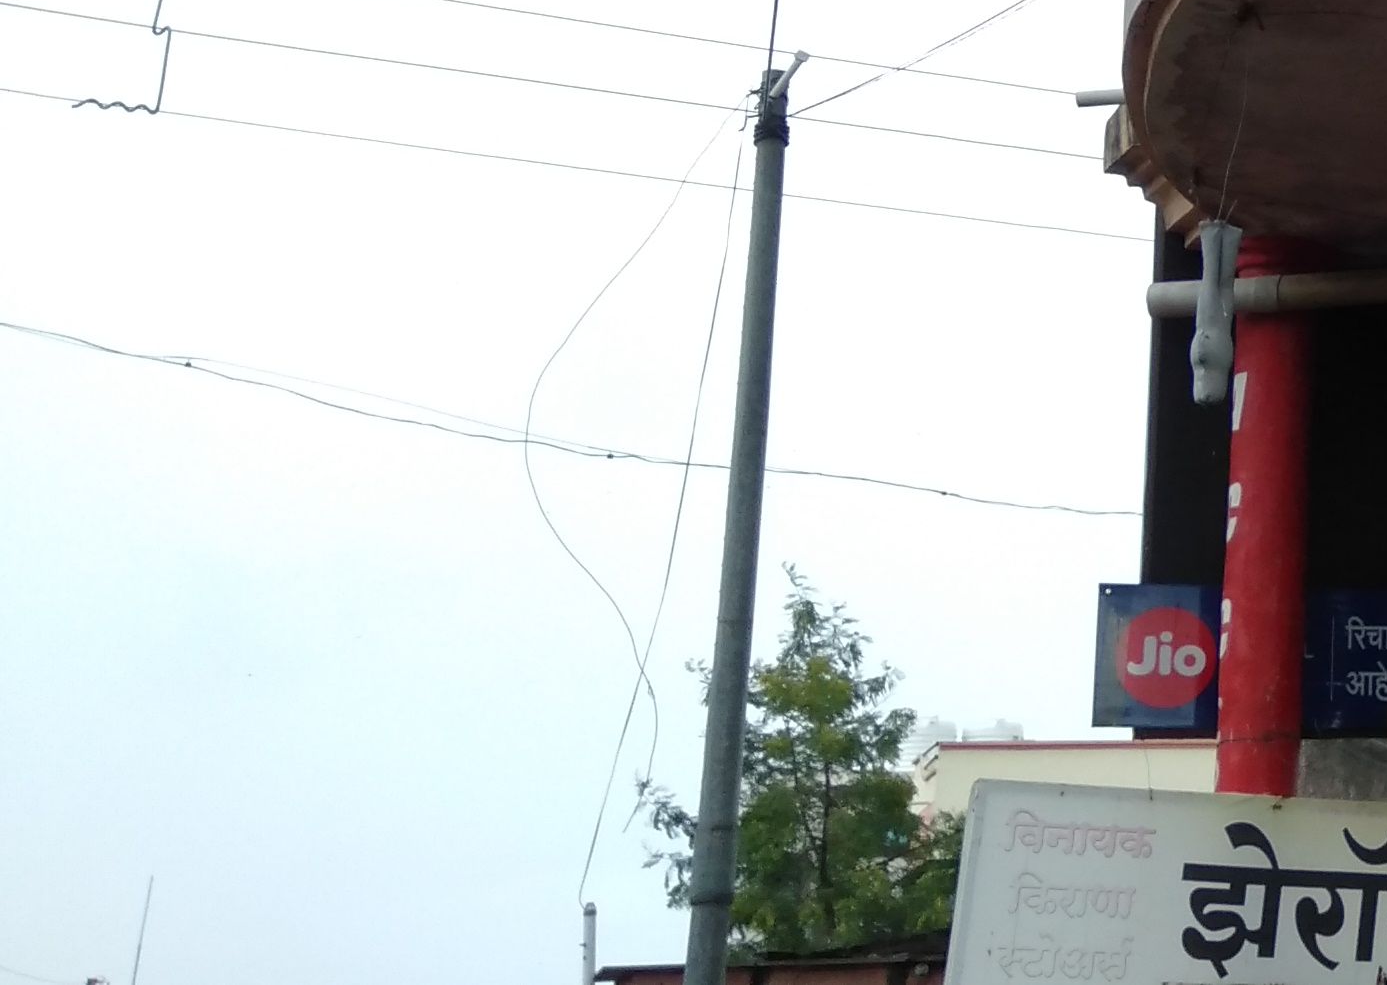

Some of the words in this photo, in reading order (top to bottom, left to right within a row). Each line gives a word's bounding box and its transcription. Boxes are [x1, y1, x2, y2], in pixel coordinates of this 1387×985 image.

[1127, 631, 1206, 677] Jio
[1003, 810, 1156, 858] विनायक
[1008, 872, 1136, 919] किराणा
